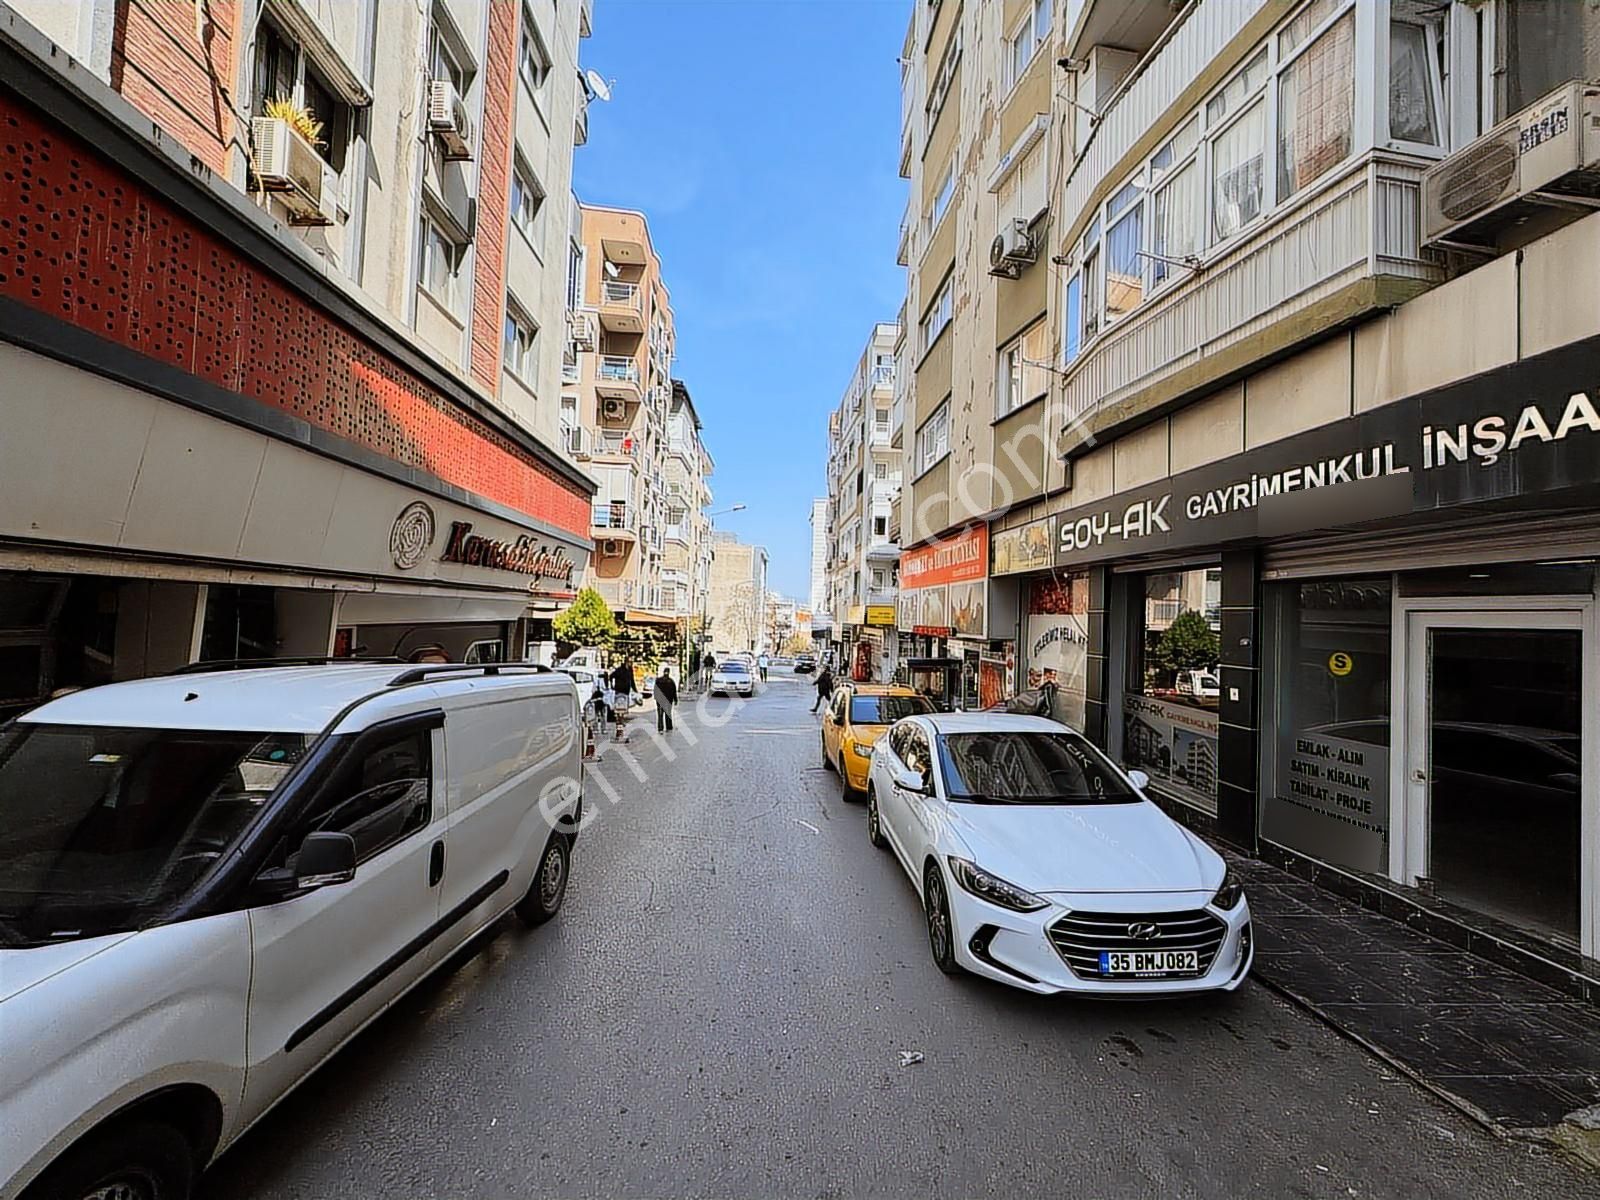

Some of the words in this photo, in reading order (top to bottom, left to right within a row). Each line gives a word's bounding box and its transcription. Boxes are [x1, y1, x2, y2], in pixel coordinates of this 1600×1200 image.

[1060, 494, 1172, 553] SOY-AK
[1186, 444, 1411, 520] GAYRİMENKUL
[1296, 738, 1330, 759] EMLAK
[1337, 748, 1365, 766] ALIM
[1290, 759, 1320, 777] SATIM
[1326, 766, 1371, 791] KİRALIK
[1289, 780, 1330, 801] TADİLAT
[1336, 792, 1372, 815] PROJE
[1110, 954, 1131, 971] 35
[1135, 953, 1164, 971] BMJ
[1166, 952, 1196, 970] 082
